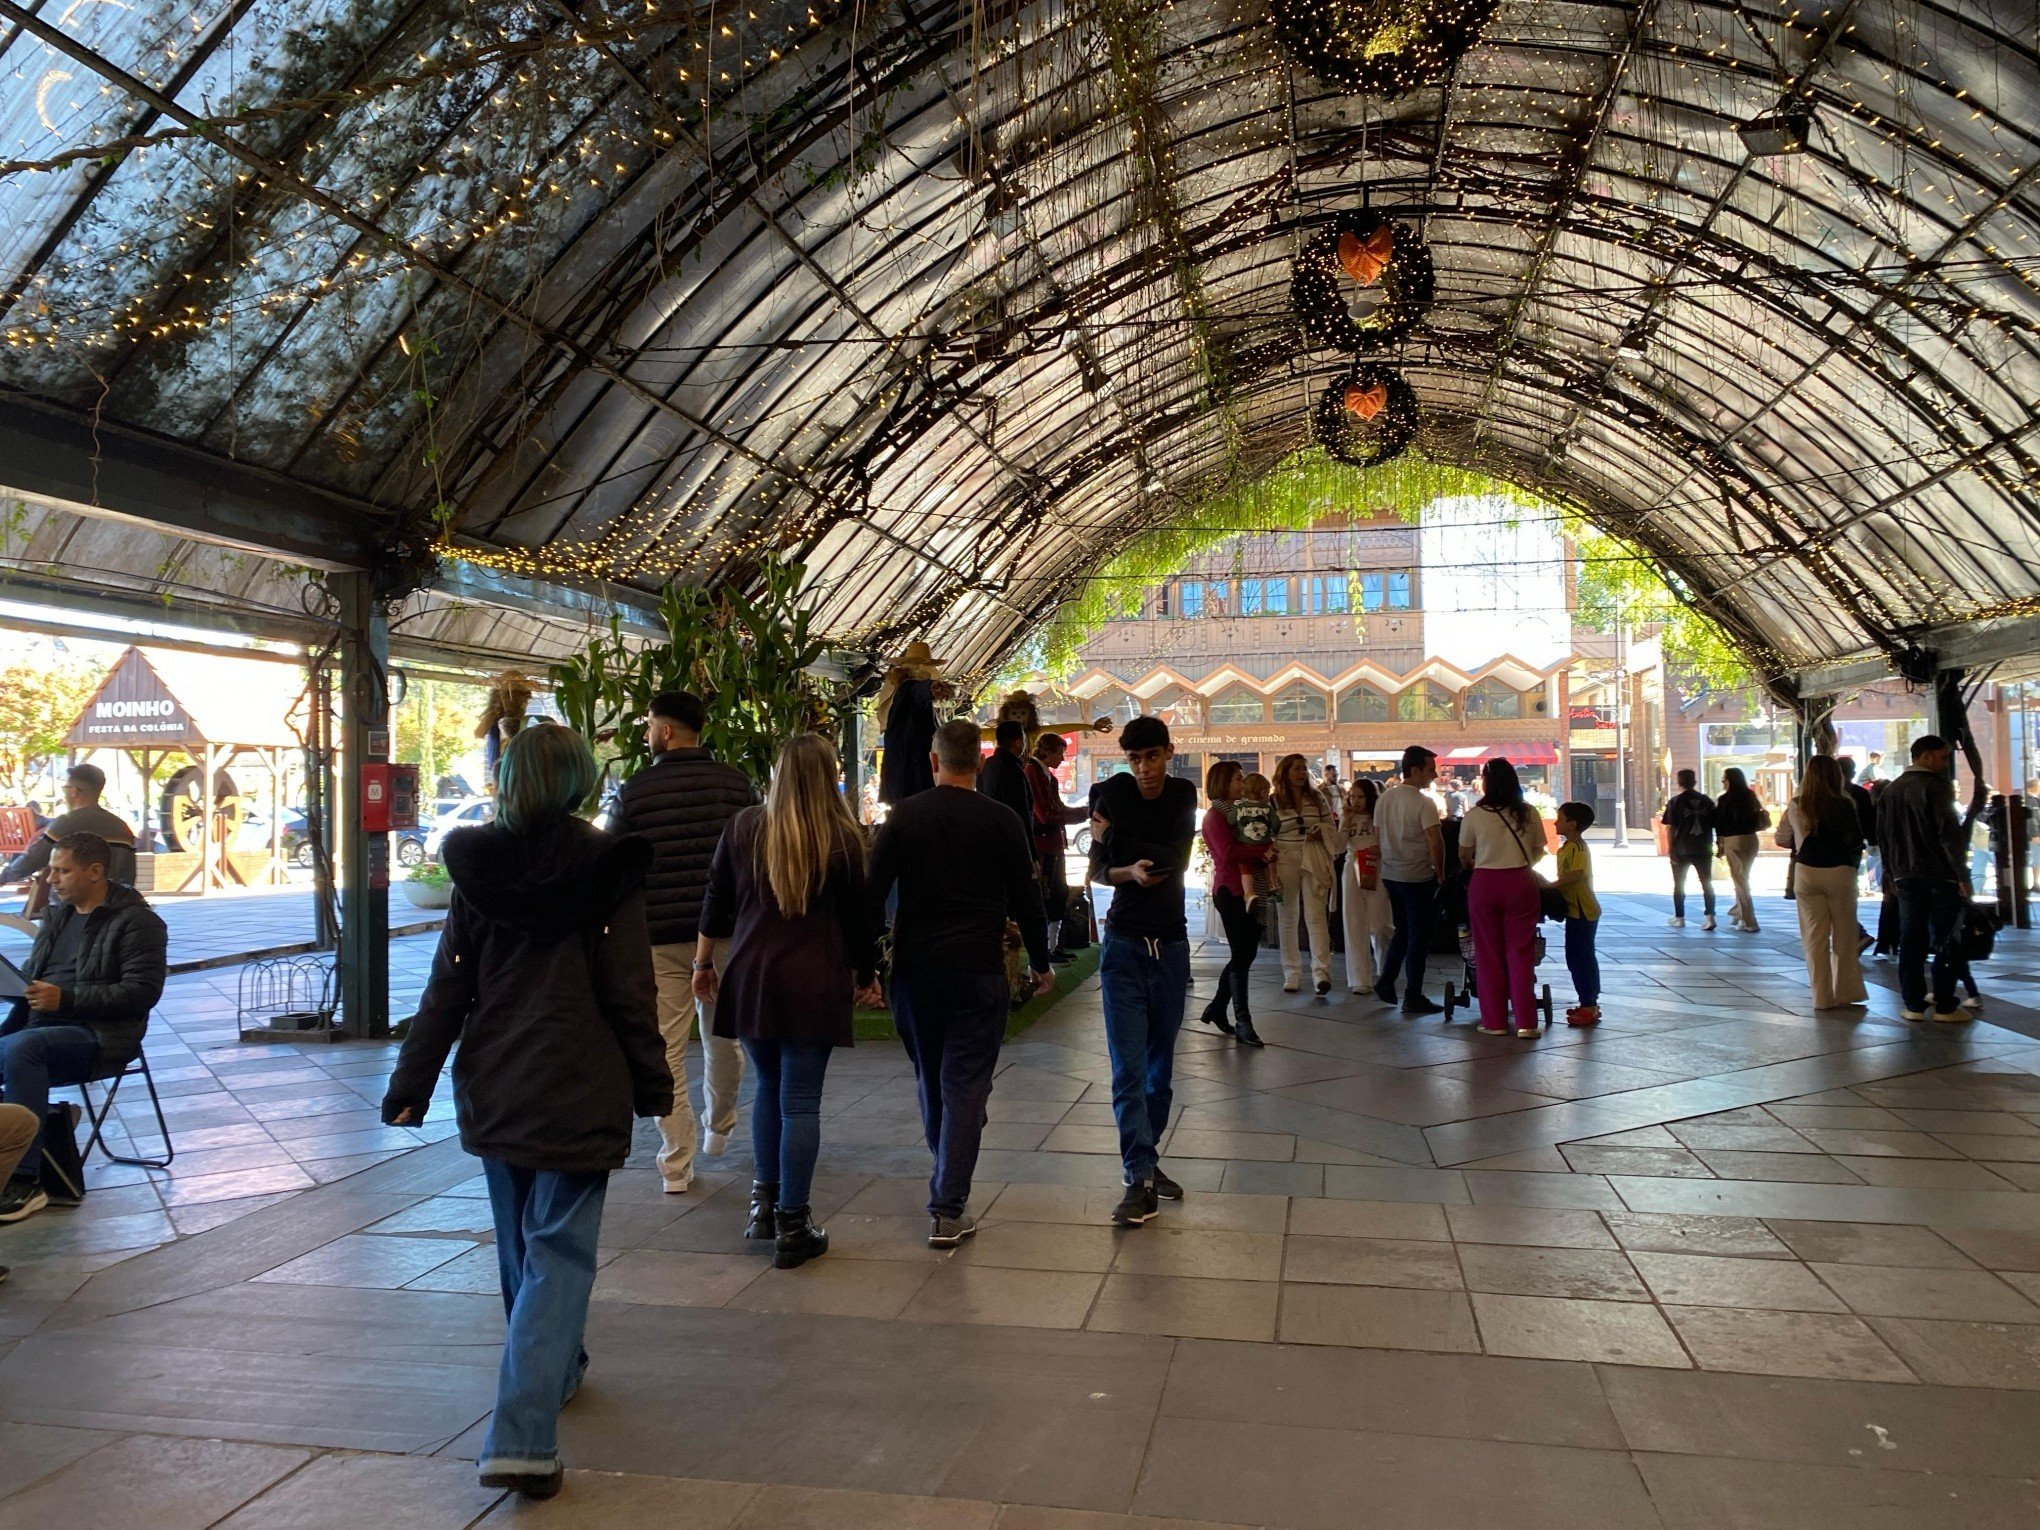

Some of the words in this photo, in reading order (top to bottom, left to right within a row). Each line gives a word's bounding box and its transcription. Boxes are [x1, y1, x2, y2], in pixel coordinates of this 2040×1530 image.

[95, 699, 175, 718] MOINHO
[88, 725, 121, 734] FESTA
[122, 724, 138, 733] DA
[139, 721, 185, 732] COLÔNIA
[1173, 735, 1185, 744] de
[1188, 735, 1222, 744] cinema
[1225, 734, 1237, 744] de
[1240, 734, 1286, 746] gramado
